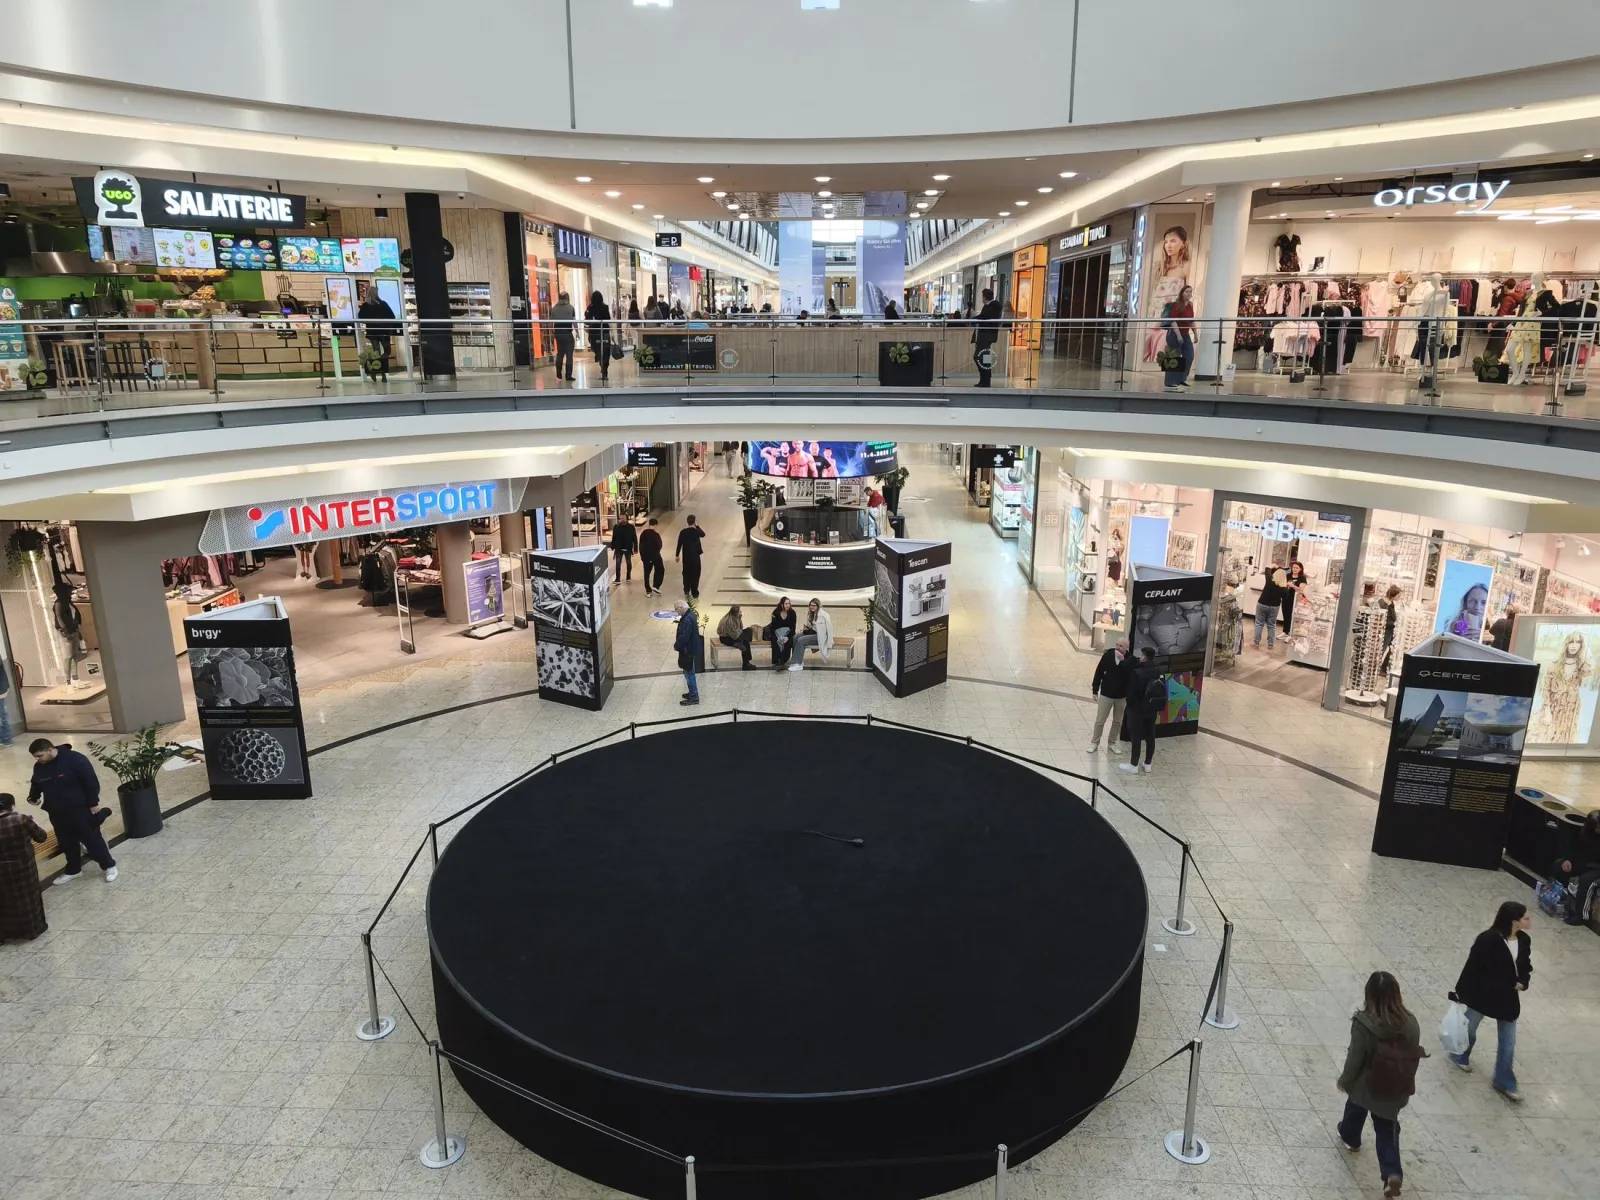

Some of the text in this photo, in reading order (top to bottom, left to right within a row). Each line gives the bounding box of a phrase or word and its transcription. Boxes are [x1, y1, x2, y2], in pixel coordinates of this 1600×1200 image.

[105, 189, 132, 200] UGO
[1374, 180, 1511, 214] orsay
[164, 189, 294, 222] SALATERIE
[288, 483, 498, 535] INTERSPORT
[908, 558, 928, 568] Tescan
[1144, 588, 1183, 598] CEPLANT
[1432, 671, 1482, 681] CEITEC
